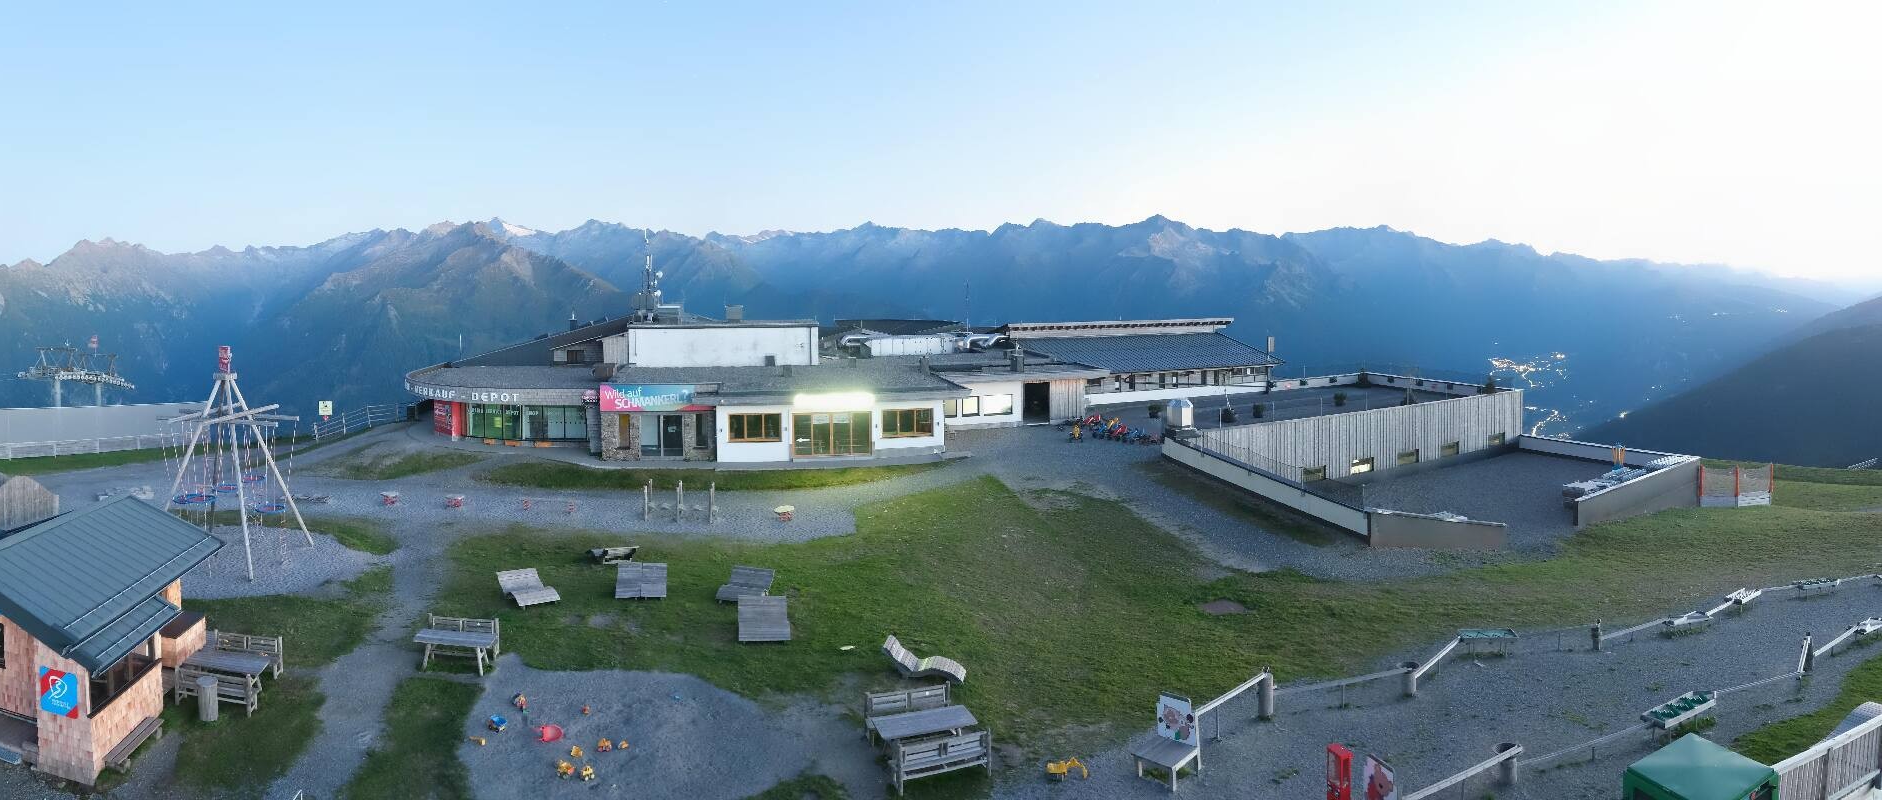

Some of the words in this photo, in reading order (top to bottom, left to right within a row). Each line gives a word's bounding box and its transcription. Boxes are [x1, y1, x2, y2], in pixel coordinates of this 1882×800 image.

[415, 385, 455, 399] VERKAUF
[472, 392, 519, 402] DEPOT
[605, 389, 625, 400] Wild
[627, 387, 642, 398] auf
